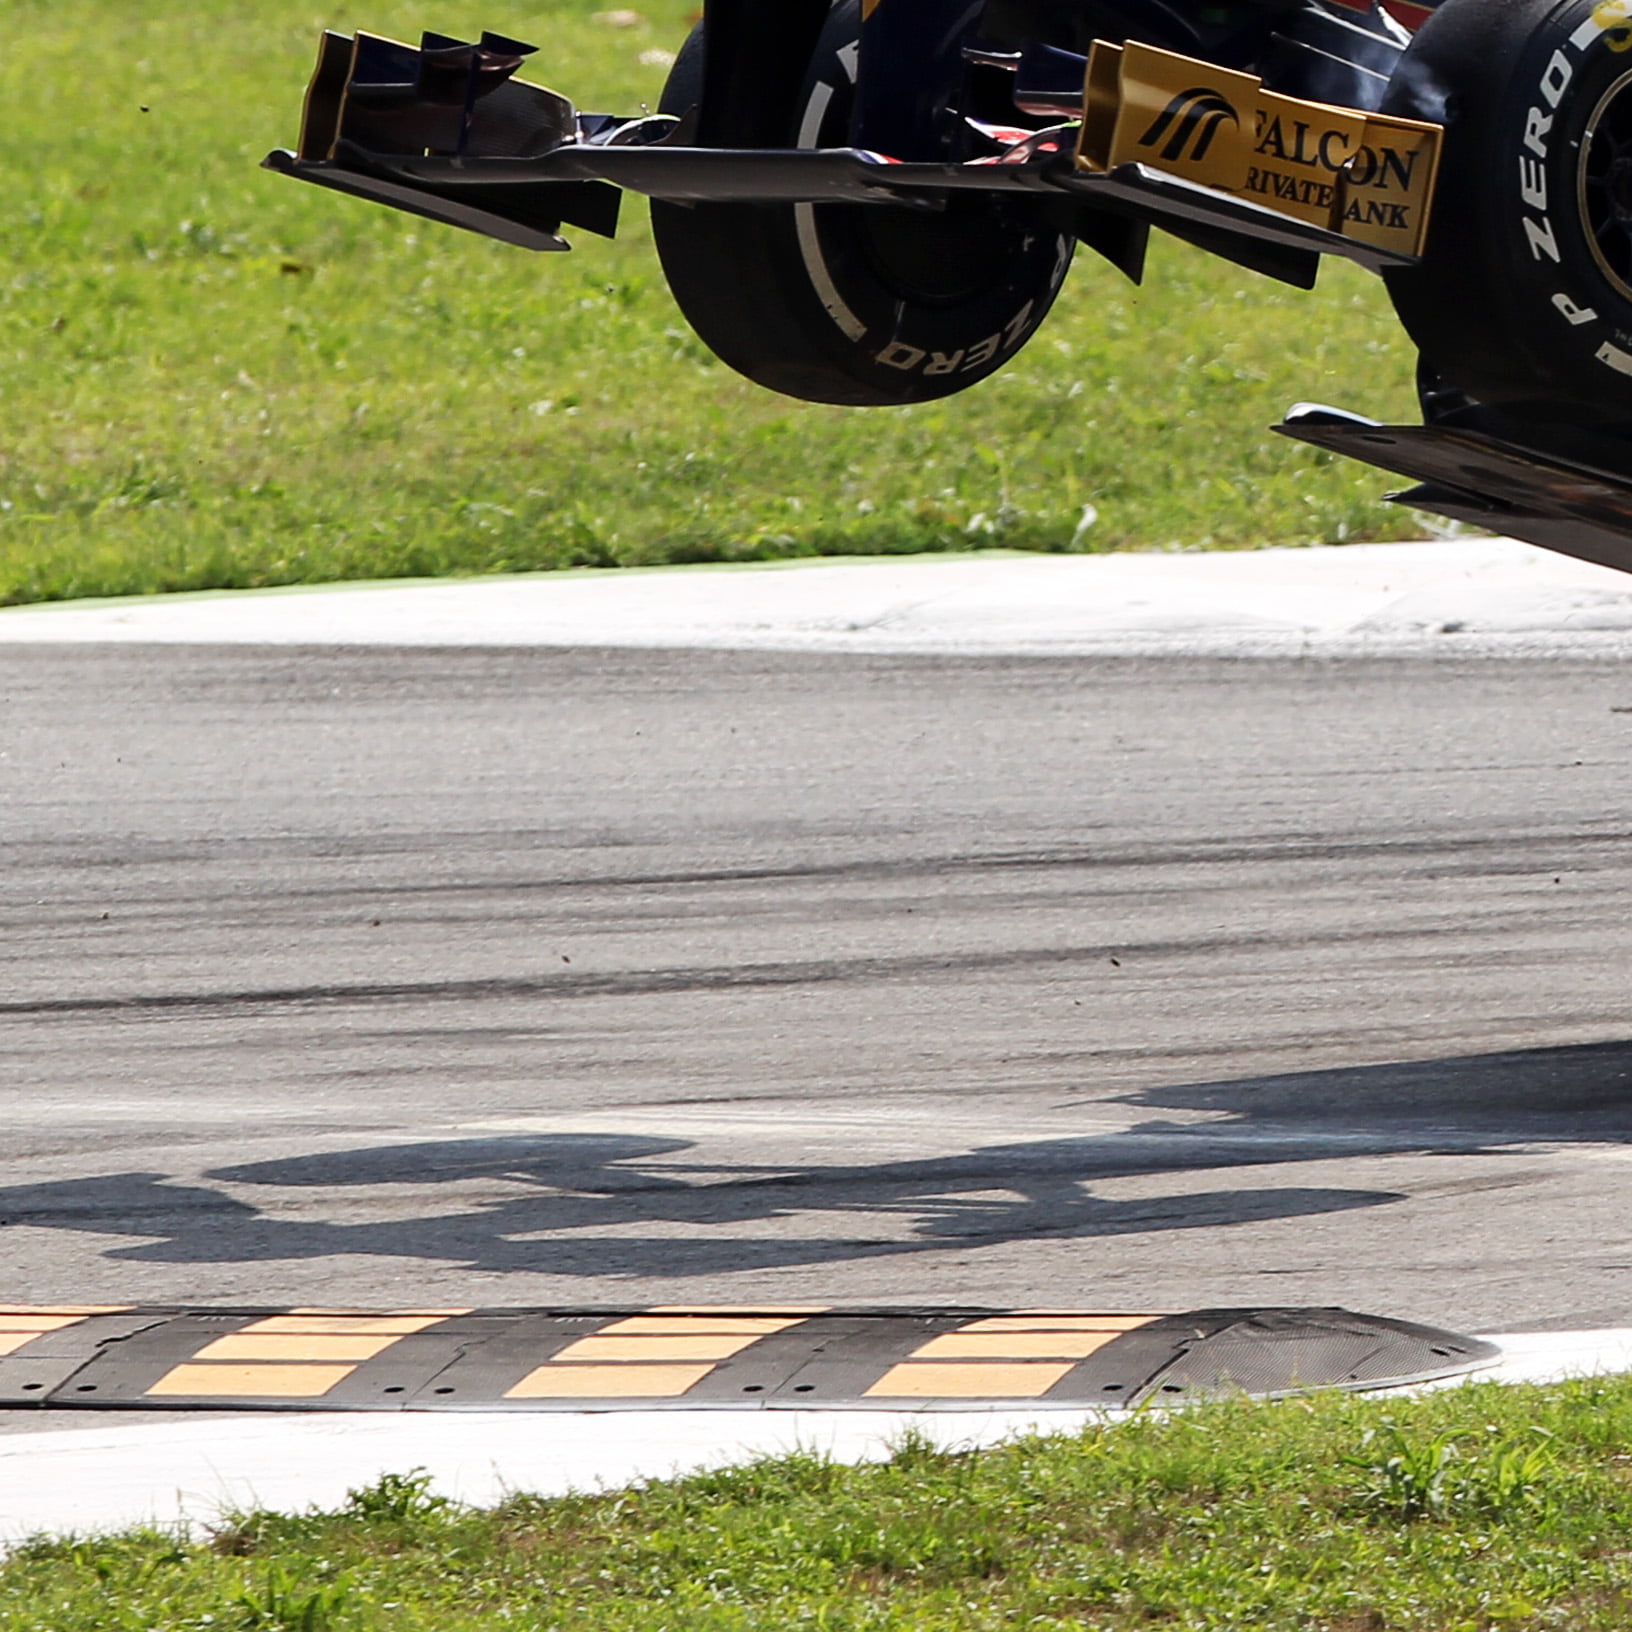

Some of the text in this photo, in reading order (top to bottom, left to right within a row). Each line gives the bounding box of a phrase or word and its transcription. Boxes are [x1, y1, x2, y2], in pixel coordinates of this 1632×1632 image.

[1246, 167, 1411, 229] RIVATE ANK
[1519, 48, 1574, 263] ZERO
